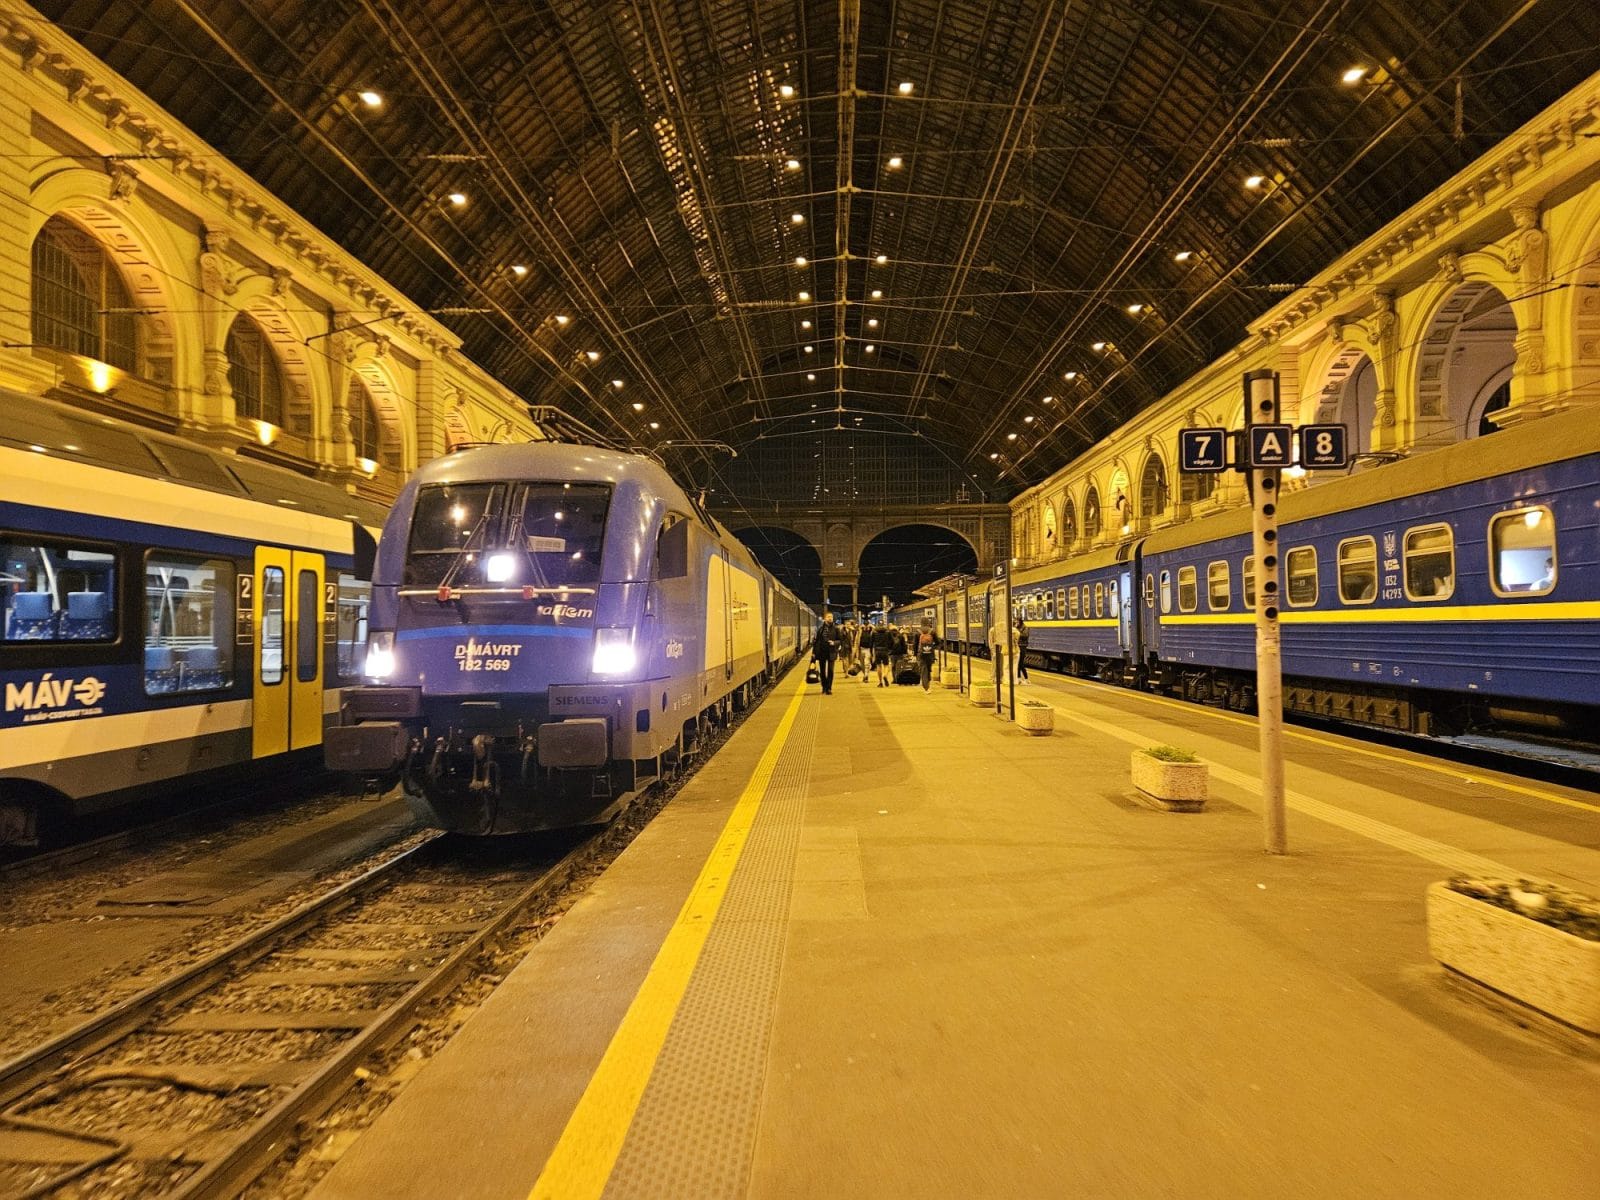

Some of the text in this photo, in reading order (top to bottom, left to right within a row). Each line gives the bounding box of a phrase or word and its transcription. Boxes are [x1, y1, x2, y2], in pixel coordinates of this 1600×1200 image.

[1195, 436, 1211, 458] 7
[1260, 432, 1283, 455] A
[1316, 432, 1333, 455] 8
[241, 578, 251, 598] 2
[326, 586, 335, 603] 2
[458, 659, 511, 671] 182 569
[5, 672, 74, 712] MÁV
[555, 696, 609, 706] SIEMENS
